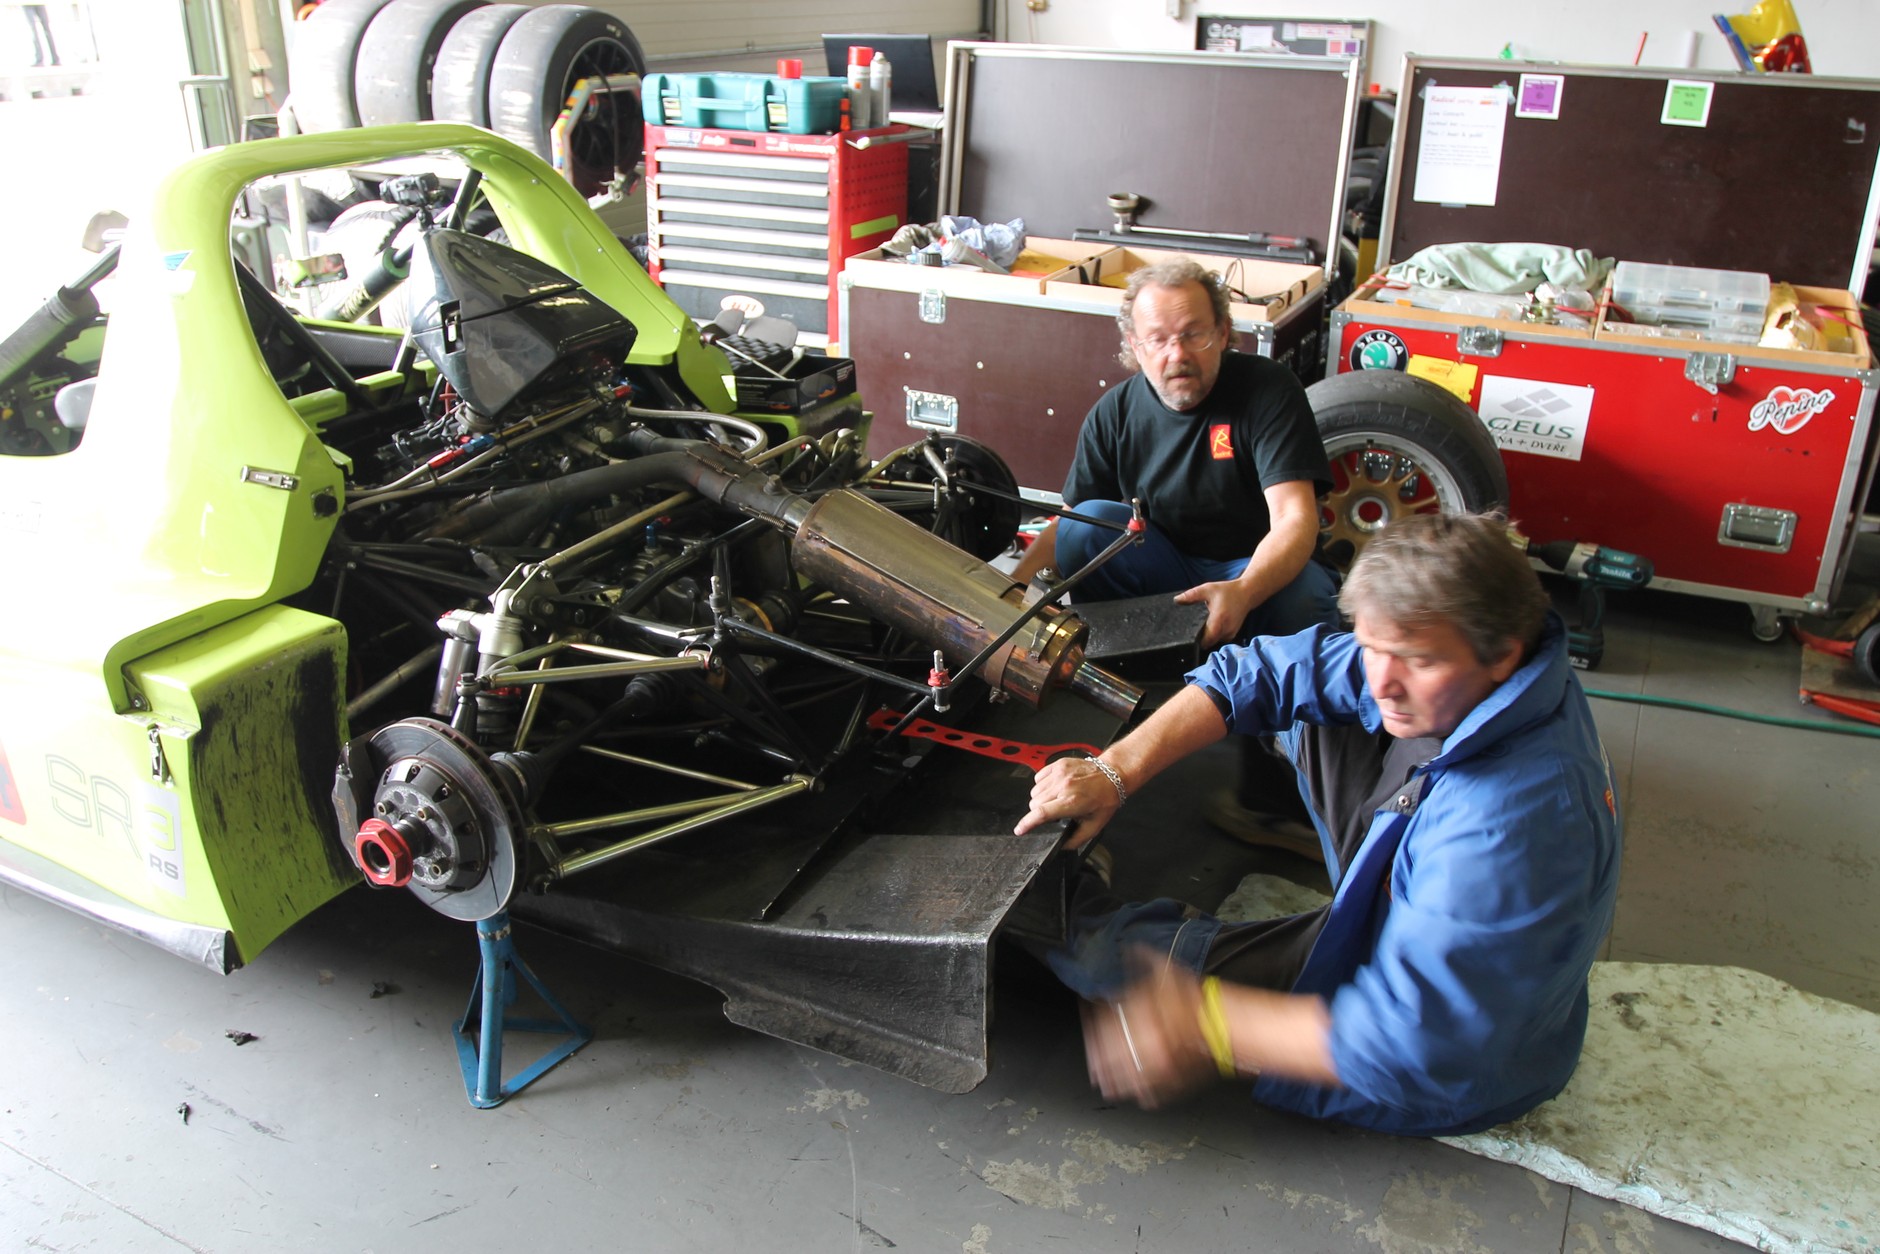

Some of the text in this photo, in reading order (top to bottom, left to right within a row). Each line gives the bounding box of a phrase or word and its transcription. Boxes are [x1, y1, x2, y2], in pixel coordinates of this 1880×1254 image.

[1750, 391, 1830, 427] Pepino
[1487, 417, 1575, 439] GEUS
[149, 853, 180, 881] RS
